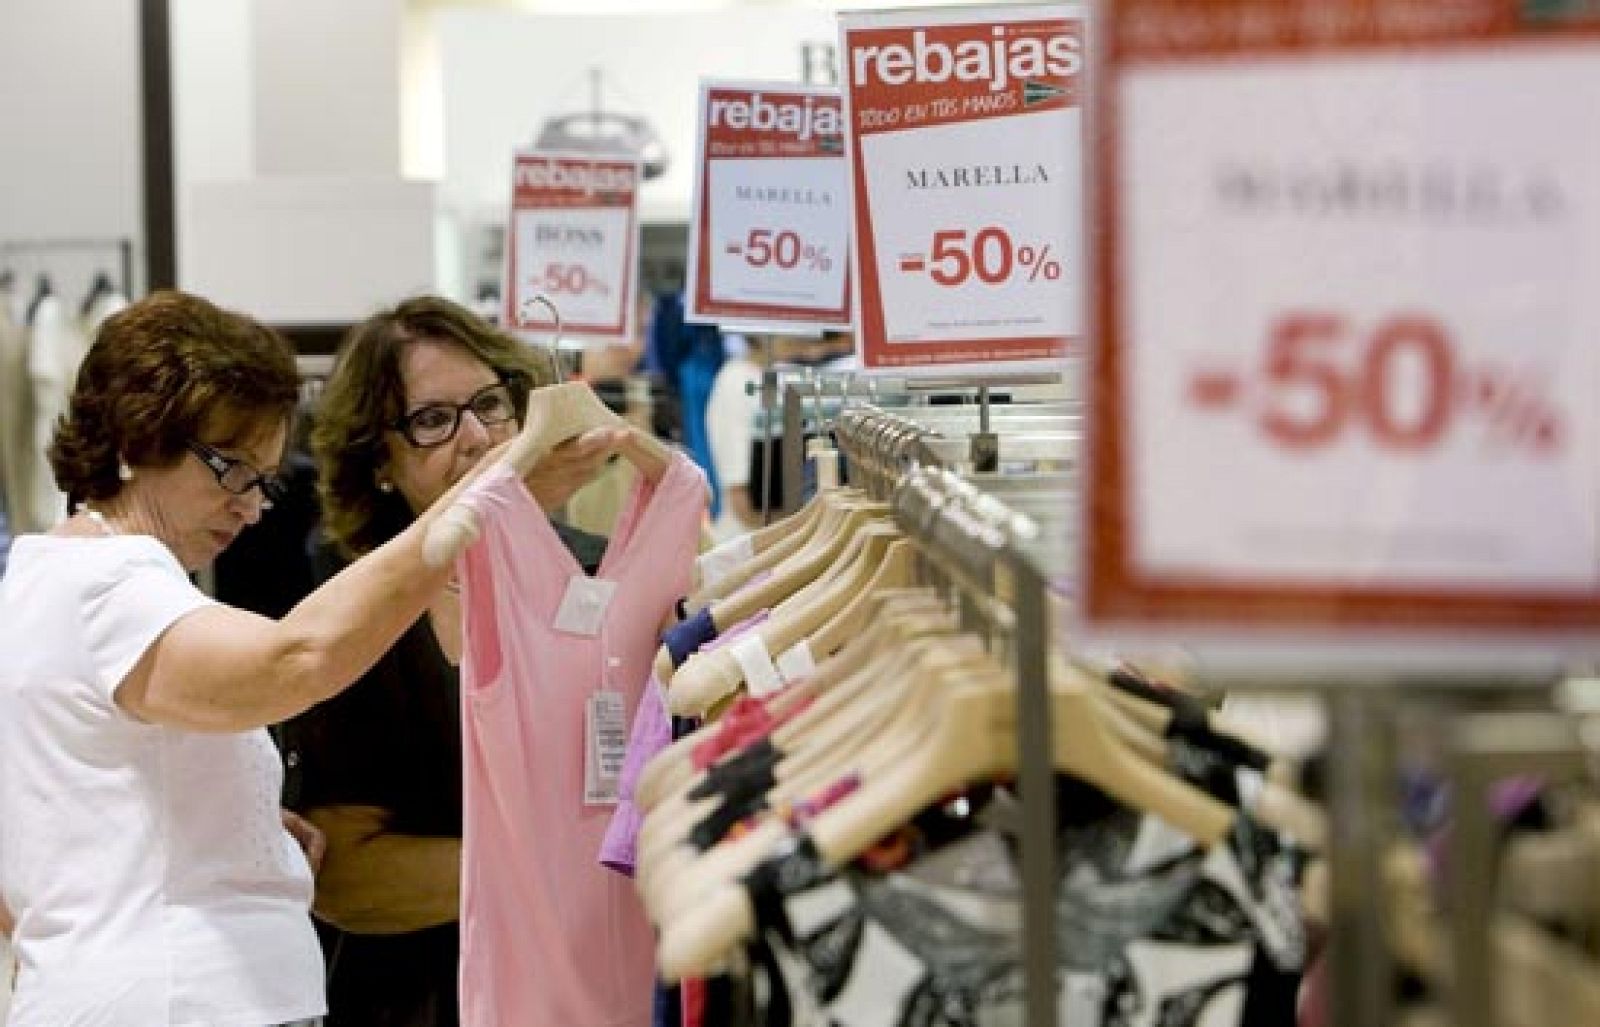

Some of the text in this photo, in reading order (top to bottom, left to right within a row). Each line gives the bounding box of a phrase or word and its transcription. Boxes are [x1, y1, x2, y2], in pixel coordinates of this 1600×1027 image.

[853, 26, 1081, 91] rebajas
[711, 92, 844, 140] rebaja
[906, 164, 1049, 189] MARELLA
[726, 229, 833, 273] -50%
[899, 225, 1060, 287] -50%
[1187, 311, 1566, 458] -50%
